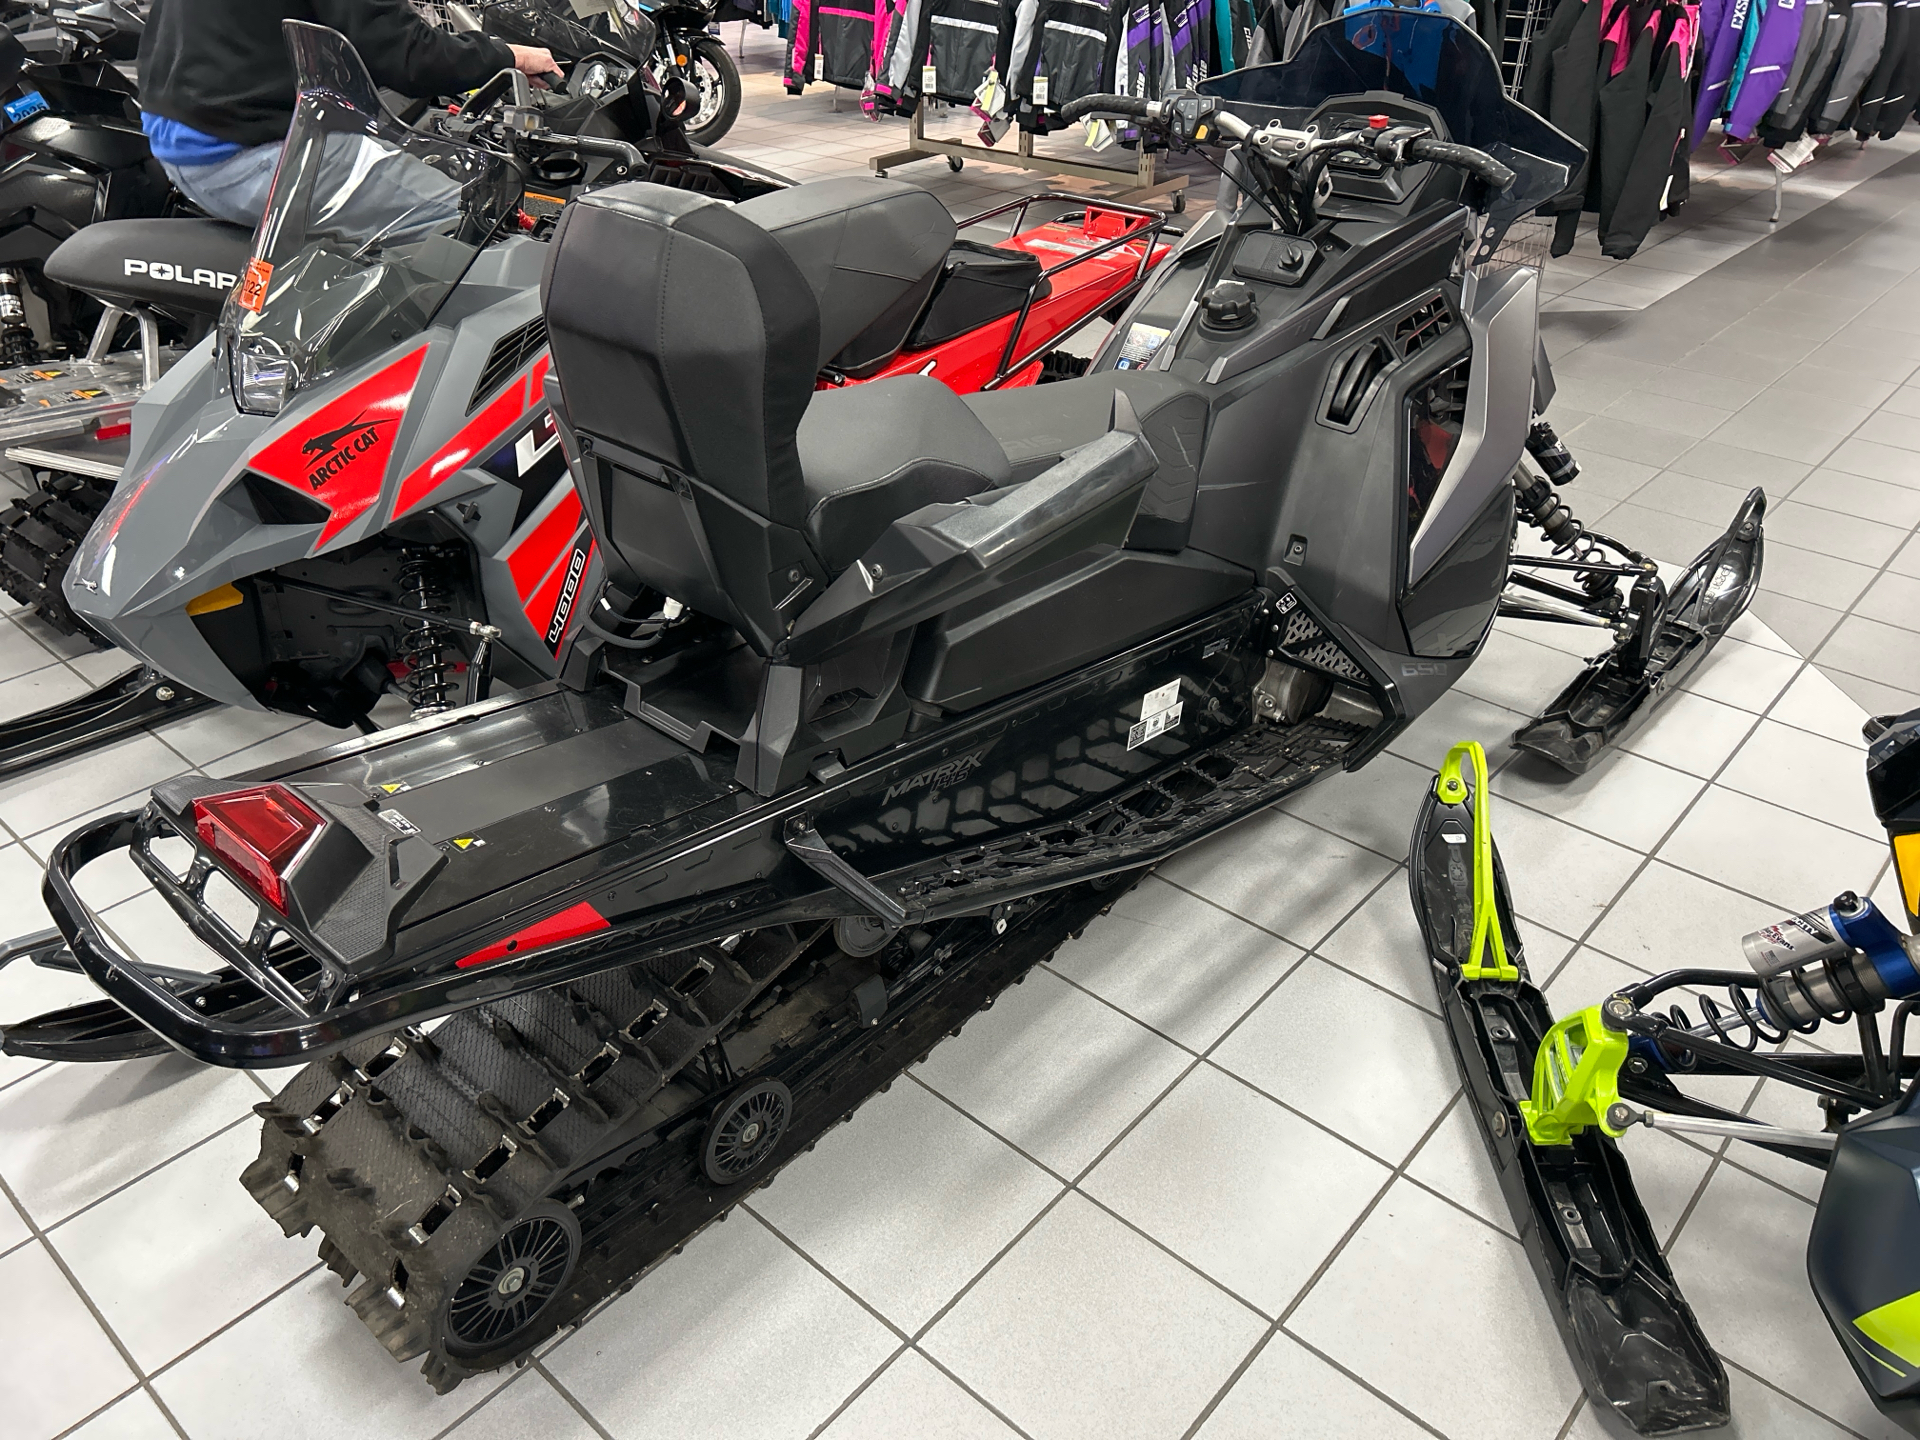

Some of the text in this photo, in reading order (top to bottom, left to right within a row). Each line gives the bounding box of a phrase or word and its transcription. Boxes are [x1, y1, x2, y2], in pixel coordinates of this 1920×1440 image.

[308, 427, 380, 490] ARCTIC CAT
[548, 548, 586, 643] 4000
[882, 750, 983, 806] MATRYX
